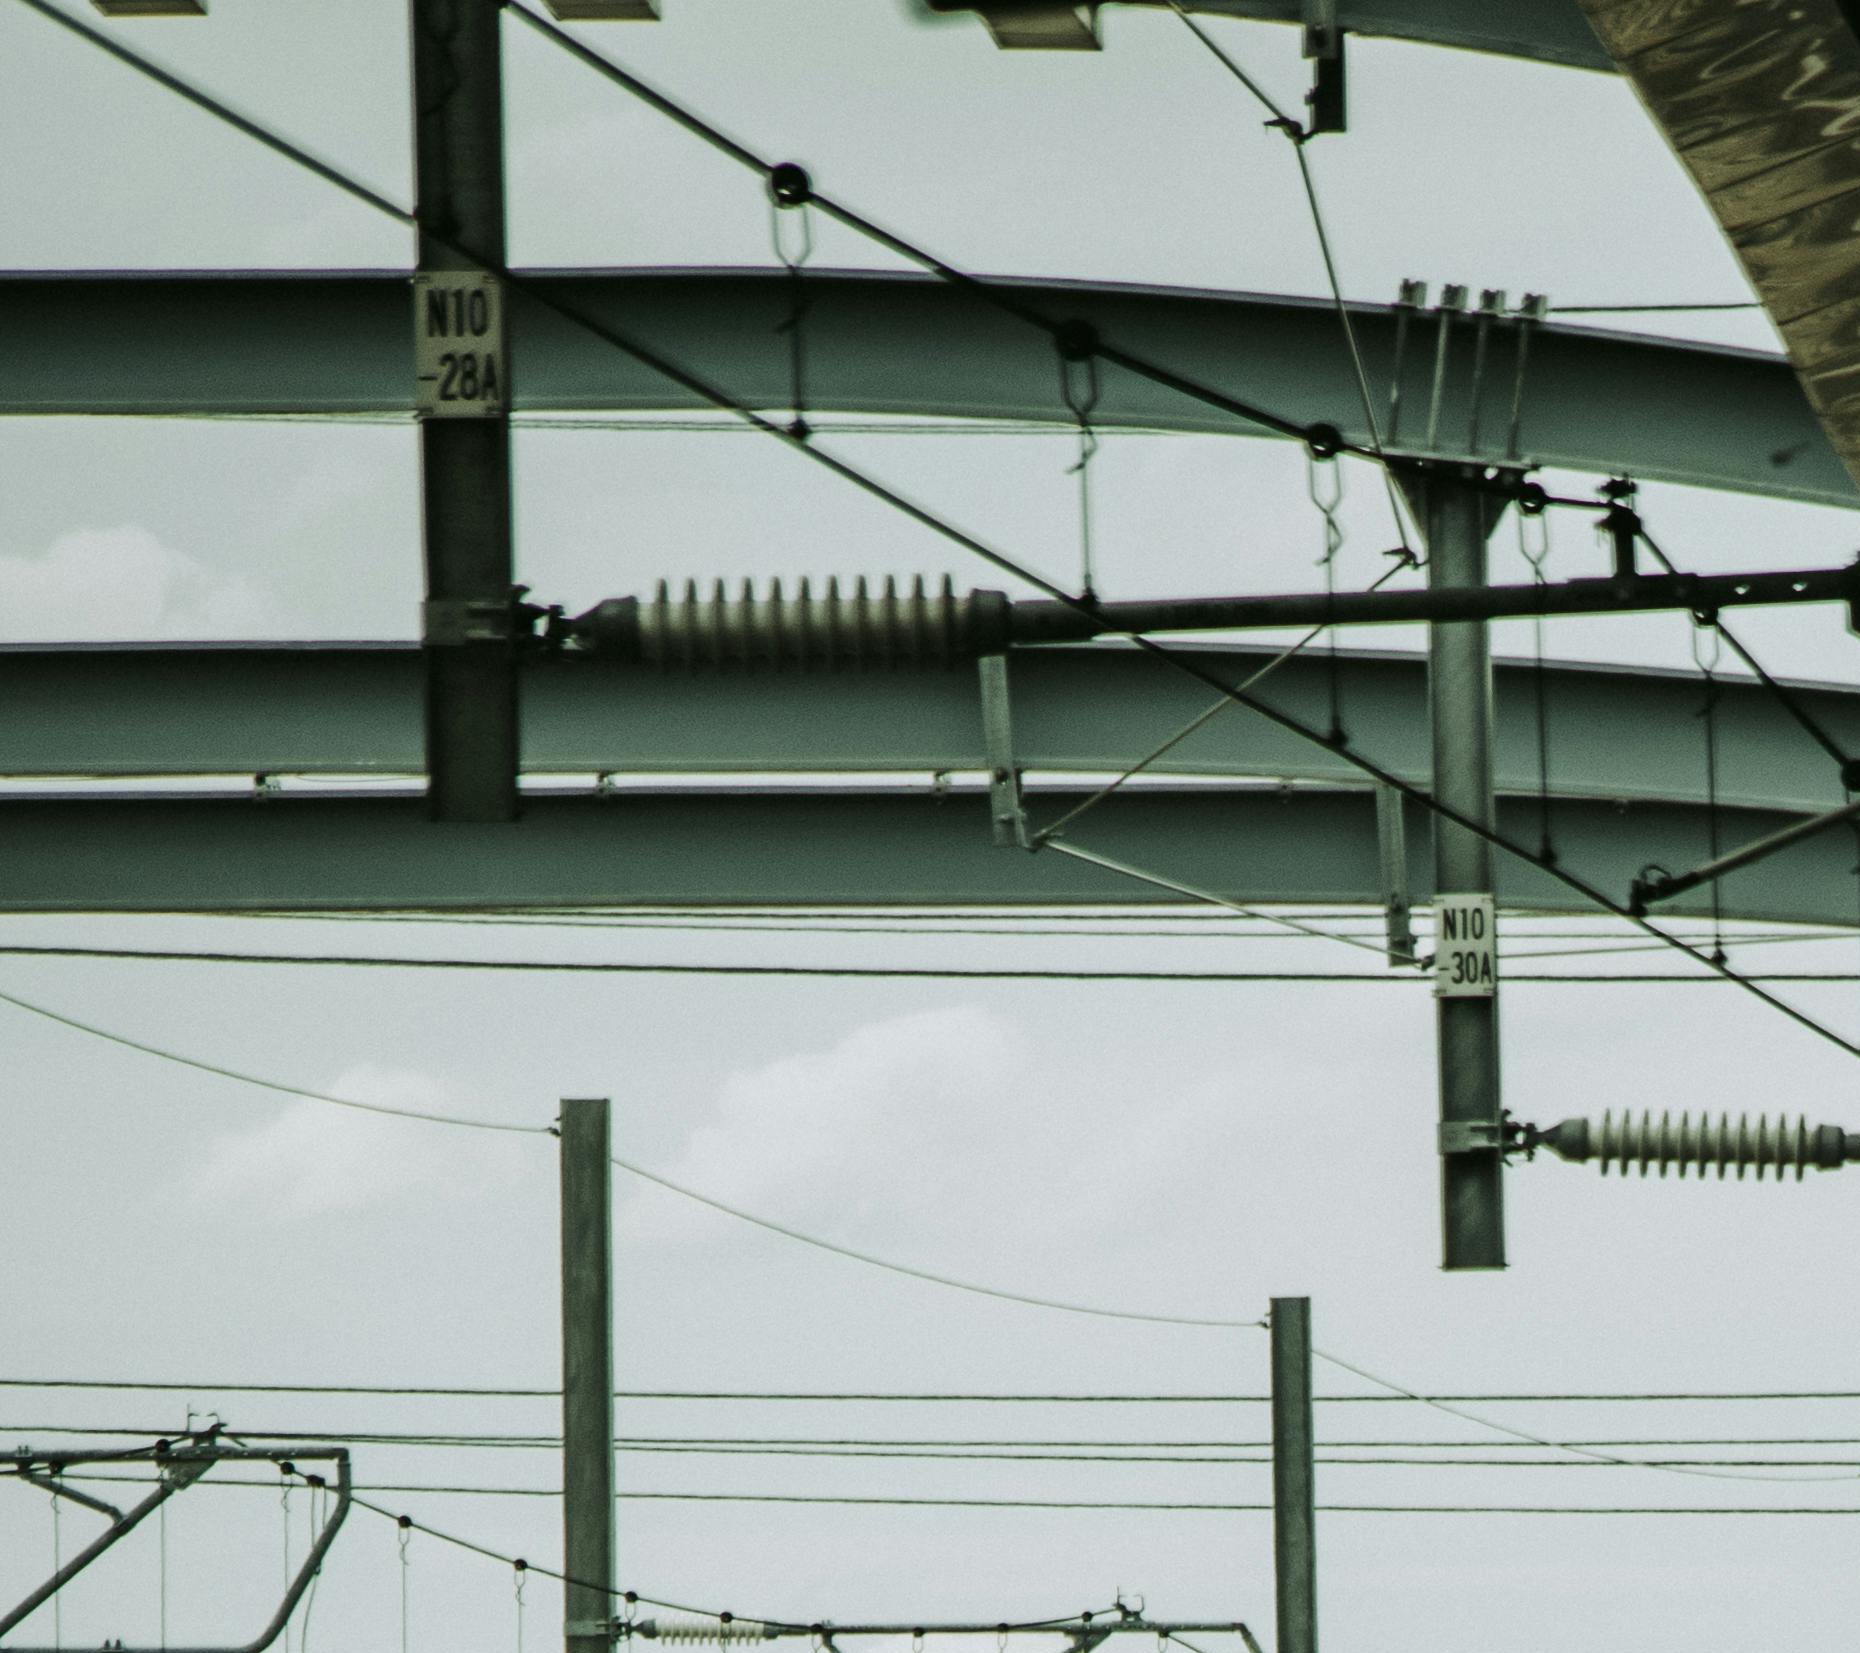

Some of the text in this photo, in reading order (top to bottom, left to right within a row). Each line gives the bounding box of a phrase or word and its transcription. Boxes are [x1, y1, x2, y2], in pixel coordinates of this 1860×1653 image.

[427, 288, 488, 338] N10
[418, 352, 499, 402] -28A
[1442, 907, 1485, 941] N10
[1438, 951, 1493, 985] -30A
